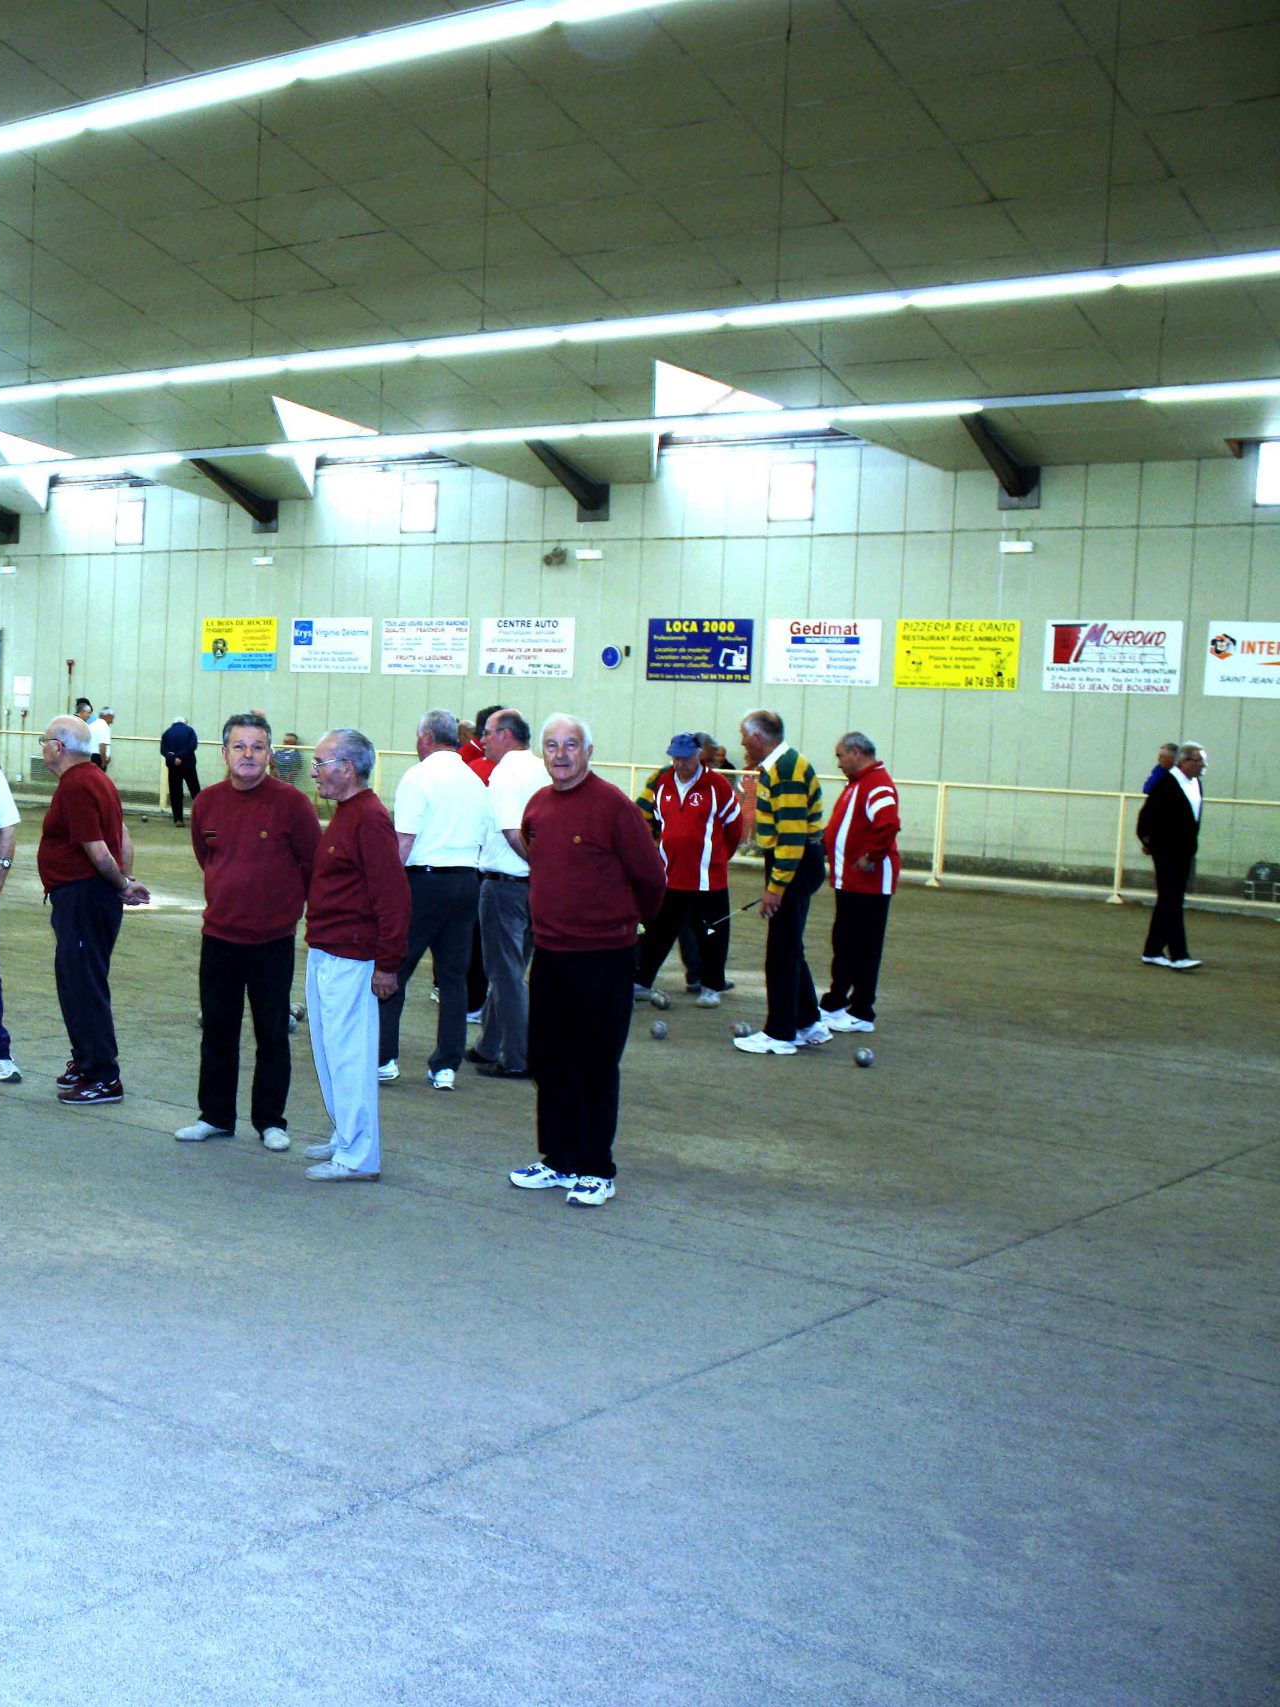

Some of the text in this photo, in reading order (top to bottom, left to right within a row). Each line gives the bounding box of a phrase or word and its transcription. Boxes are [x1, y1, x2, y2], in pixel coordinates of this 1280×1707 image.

[497, 620, 559, 628] CENTRE AUTO
[665, 621, 735, 633] LOCA 2000
[790, 621, 858, 635] Gedimat
[903, 622, 1015, 632] PIZZERIA BEL CANTO
[1248, 676, 1273, 684] JEAN
[1051, 682, 1075, 690] 38440
[1088, 683, 1109, 691] JEAN
[1126, 684, 1170, 692] BOURNAY
